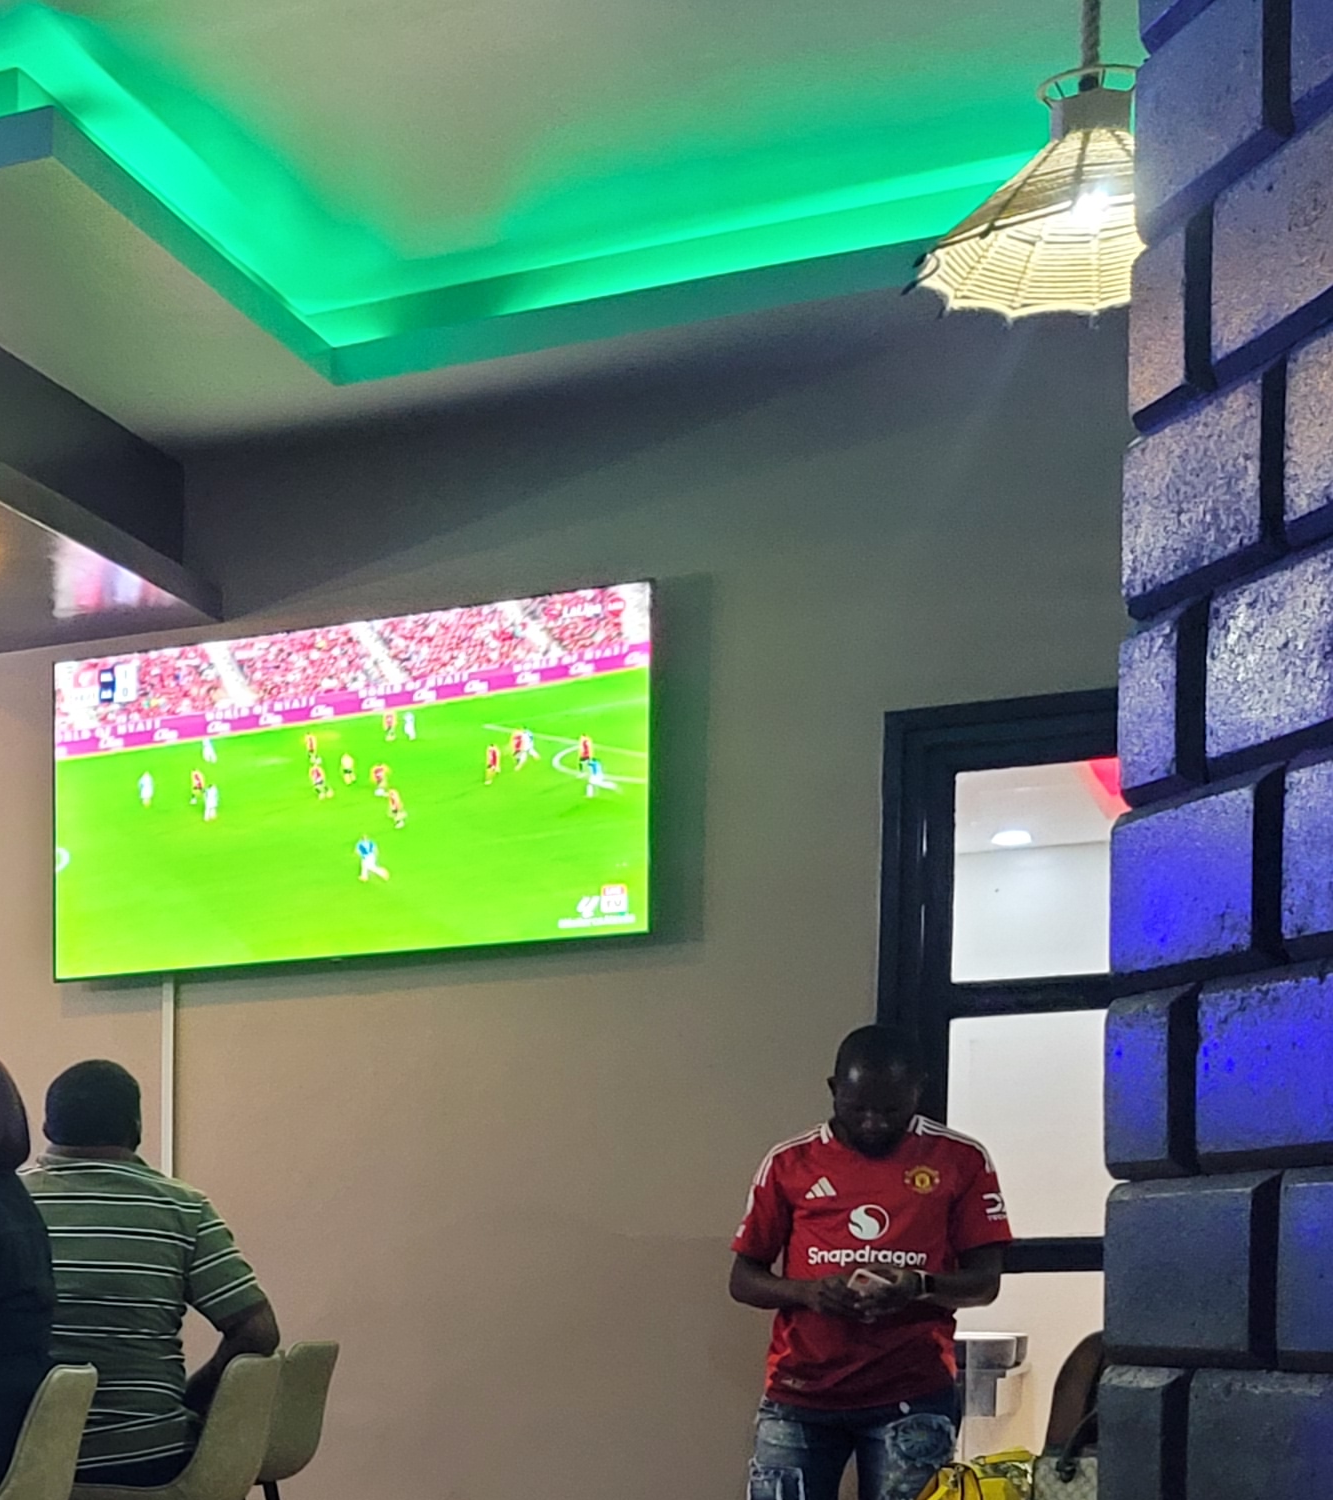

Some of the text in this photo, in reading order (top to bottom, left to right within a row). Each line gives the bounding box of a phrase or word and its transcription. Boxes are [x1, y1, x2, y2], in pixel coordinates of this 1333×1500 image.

[562, 603, 603, 618] LaLiga
[584, 644, 630, 661] HYATT
[358, 684, 402, 699] WORLD
[426, 672, 470, 688] HYATT
[205, 707, 249, 722] WORLD
[273, 696, 316, 712] HYATT
[116, 719, 161, 735] HYATT
[807, 1245, 927, 1267] Snapdragon
